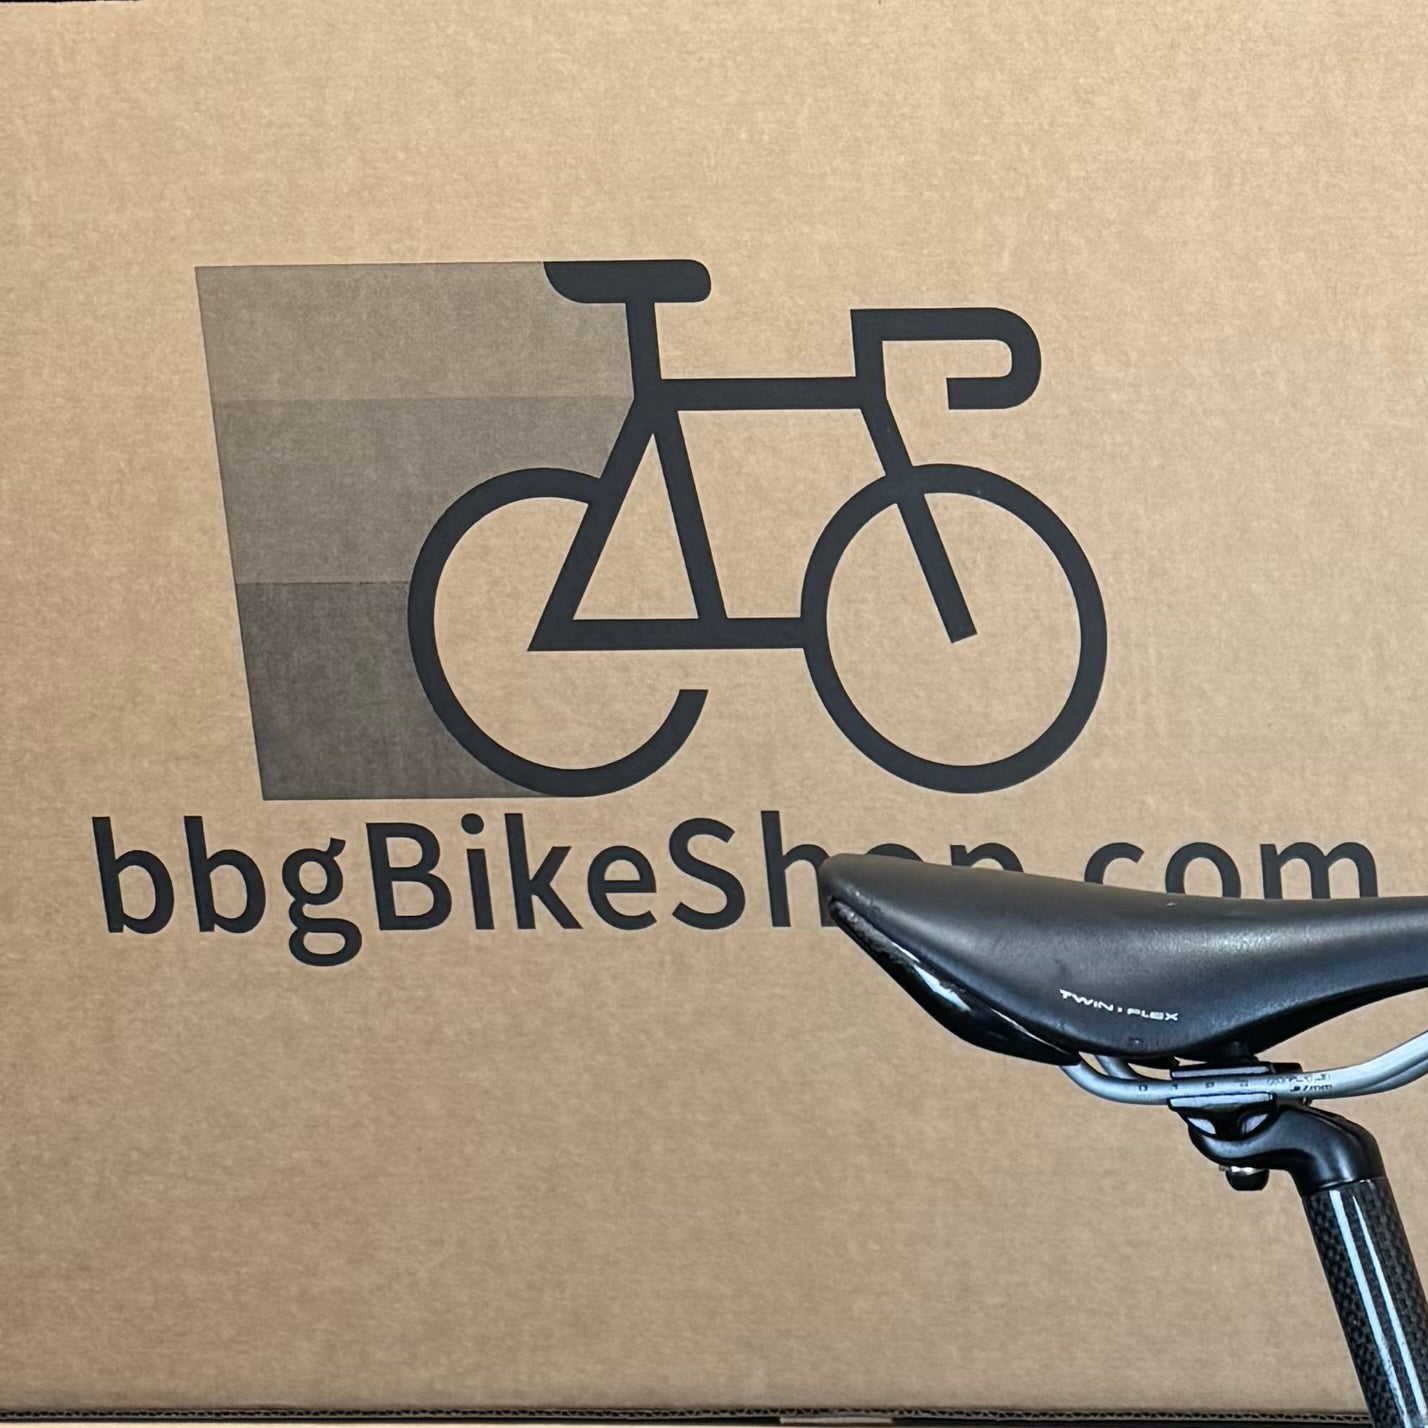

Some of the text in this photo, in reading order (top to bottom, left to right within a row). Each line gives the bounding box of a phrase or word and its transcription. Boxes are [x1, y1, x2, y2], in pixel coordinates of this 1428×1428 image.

[91, 808, 1379, 967] bbgBikeShom
[1060, 989, 1179, 1022] TWIN FLEX
